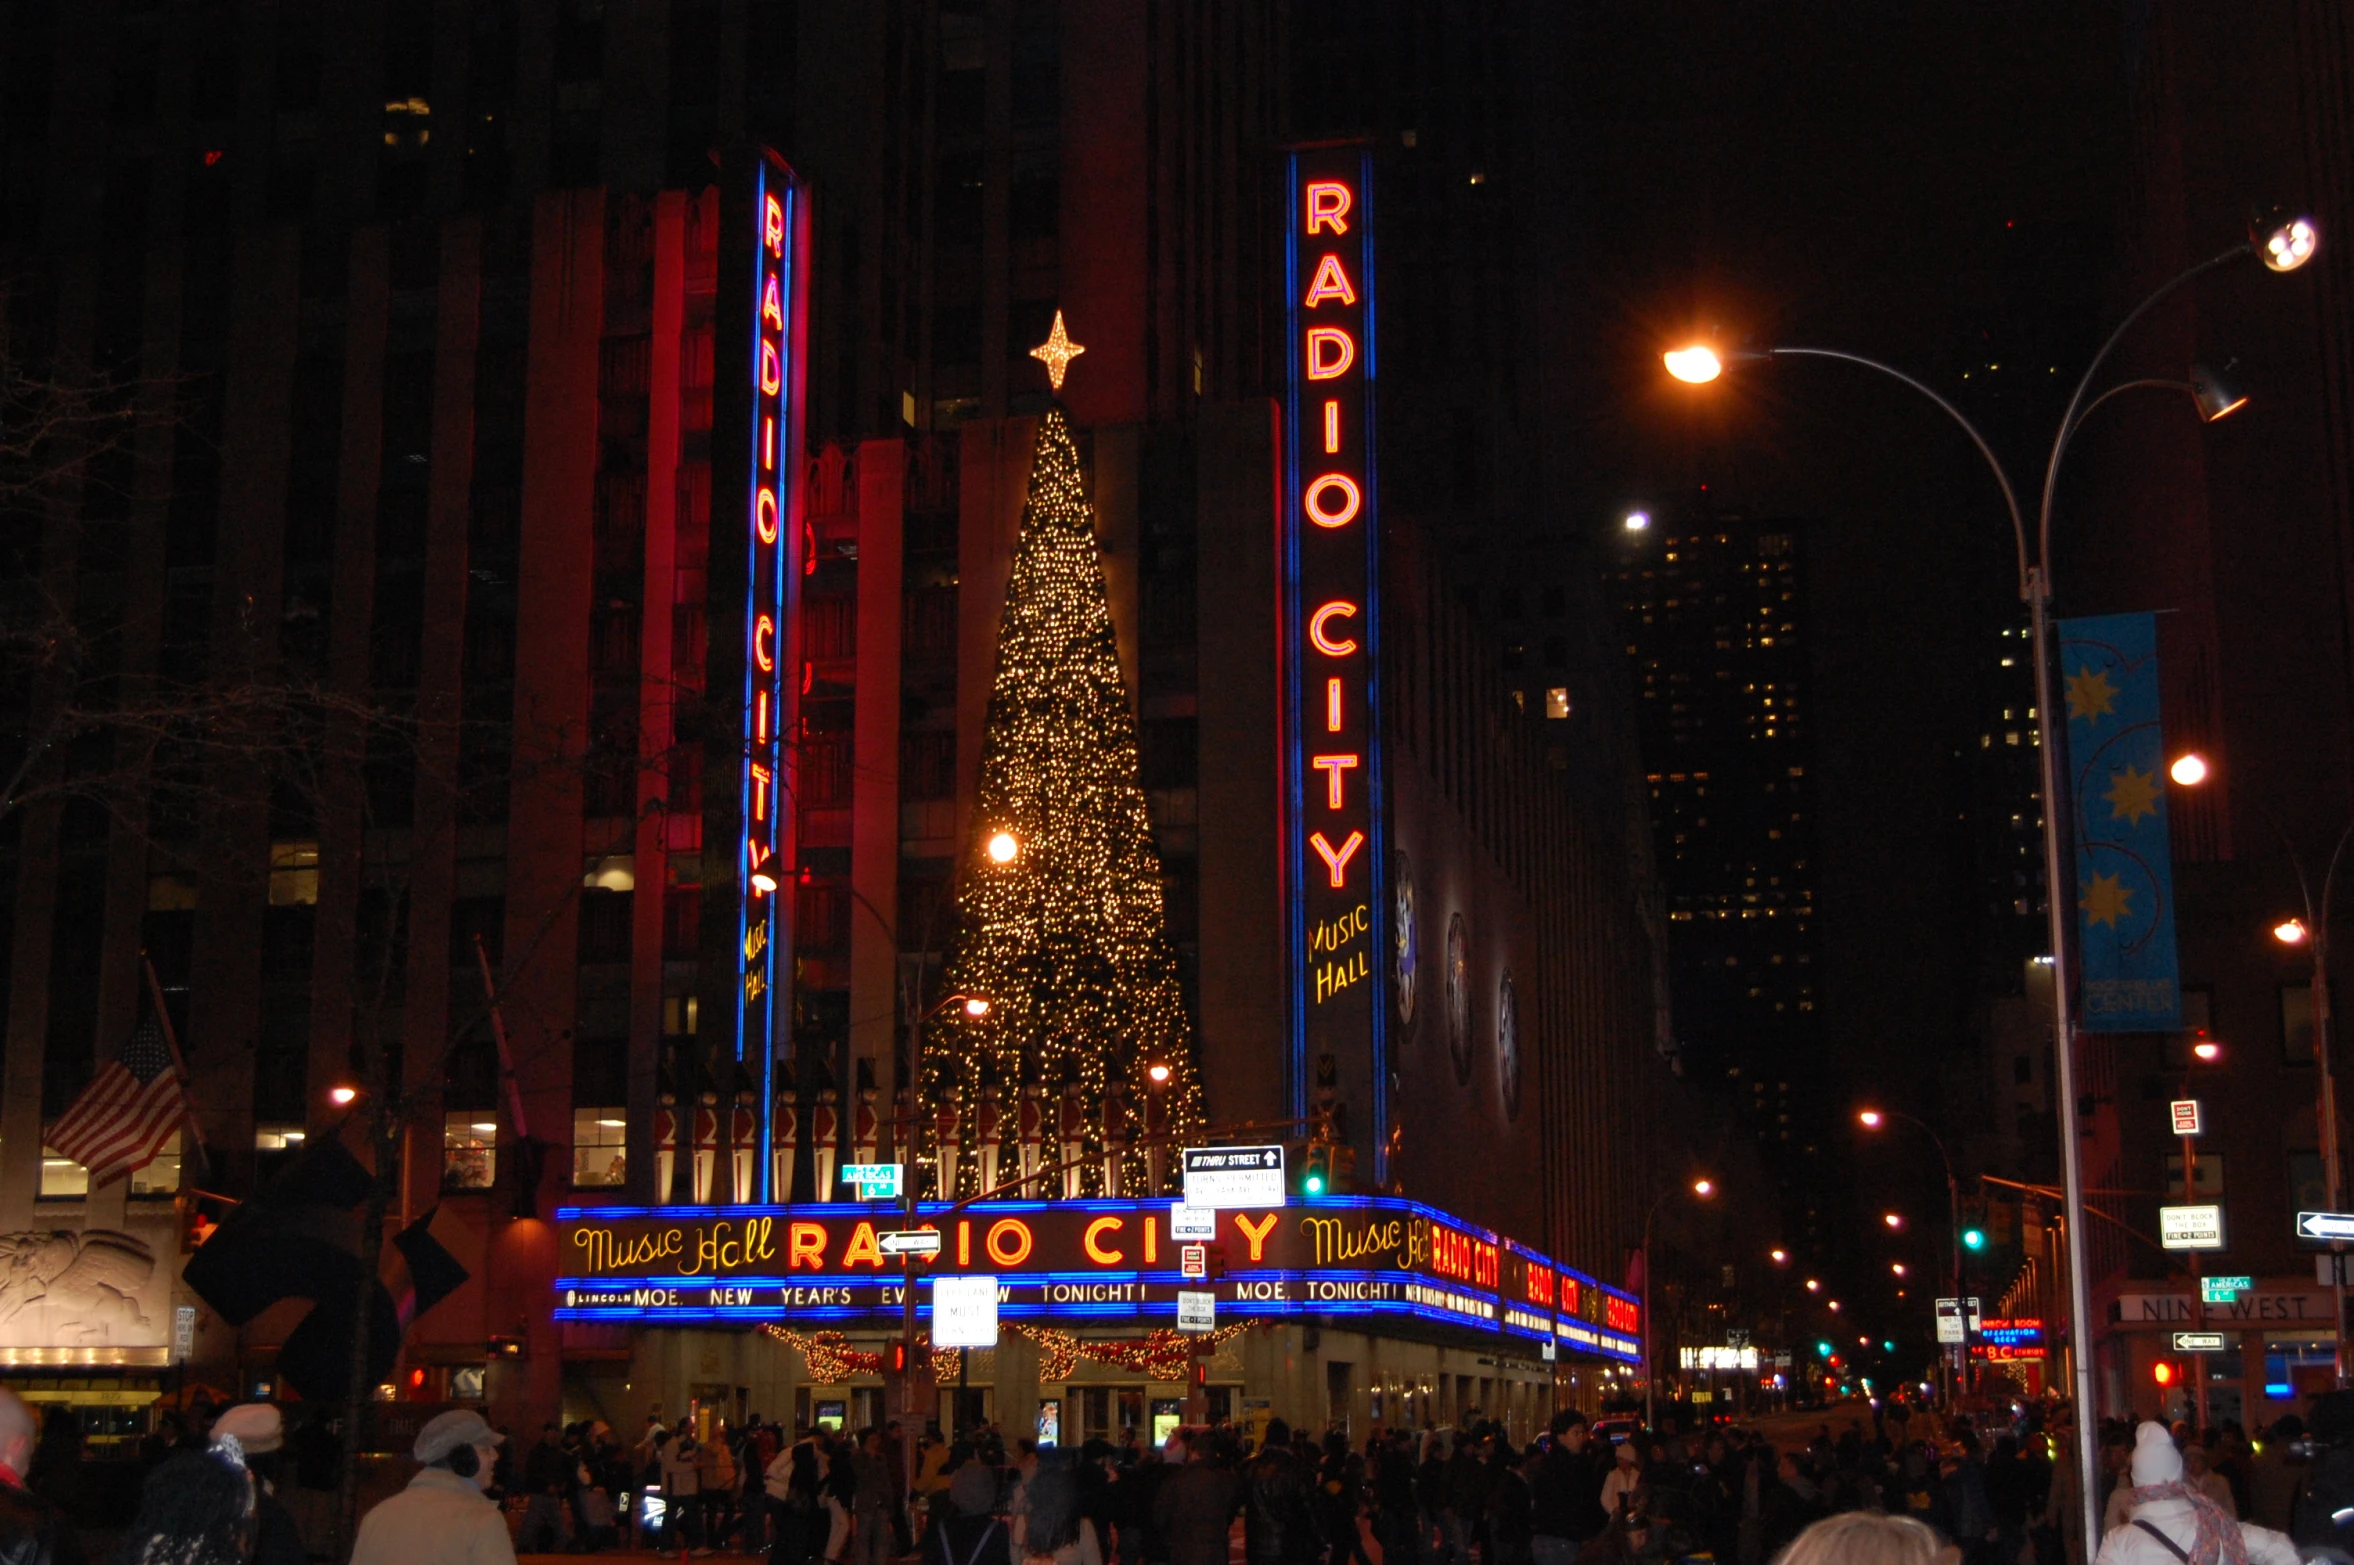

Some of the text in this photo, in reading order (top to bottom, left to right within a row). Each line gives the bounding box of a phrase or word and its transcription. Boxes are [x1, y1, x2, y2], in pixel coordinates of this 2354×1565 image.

[757, 195, 783, 544] RADIO
[1305, 182, 1364, 888] RADIO CITY
[1316, 951, 1369, 1004] HALL
[1202, 1154, 1260, 1166] THRU STREET
[1226, 1172, 1277, 1183] PERMITTED
[867, 1184, 876, 1196] 6
[790, 1213, 1279, 1268] RAIO CIY
[1301, 1217, 1431, 1270] Music Hall
[2194, 1231, 2216, 1239] POINTS
[575, 1216, 775, 1275] Music Hall
[1431, 1224, 1498, 1288] RADIO CITY
[2211, 1280, 2248, 1288] AMERICAS
[578, 1293, 631, 1304] LINCOLN
[710, 1286, 753, 1306] NEW
[781, 1286, 852, 1306] YEAR'S
[1041, 1283, 1147, 1302] TONIGHT!
[1306, 1281, 1398, 1301] TONIGHT!
[2214, 1291, 2221, 1301] 6
[178, 1309, 193, 1322] STOP
[950, 1306, 981, 1318] MUST
[2219, 1296, 2308, 1320] WEST
[2014, 1319, 2041, 1328] ROOM
